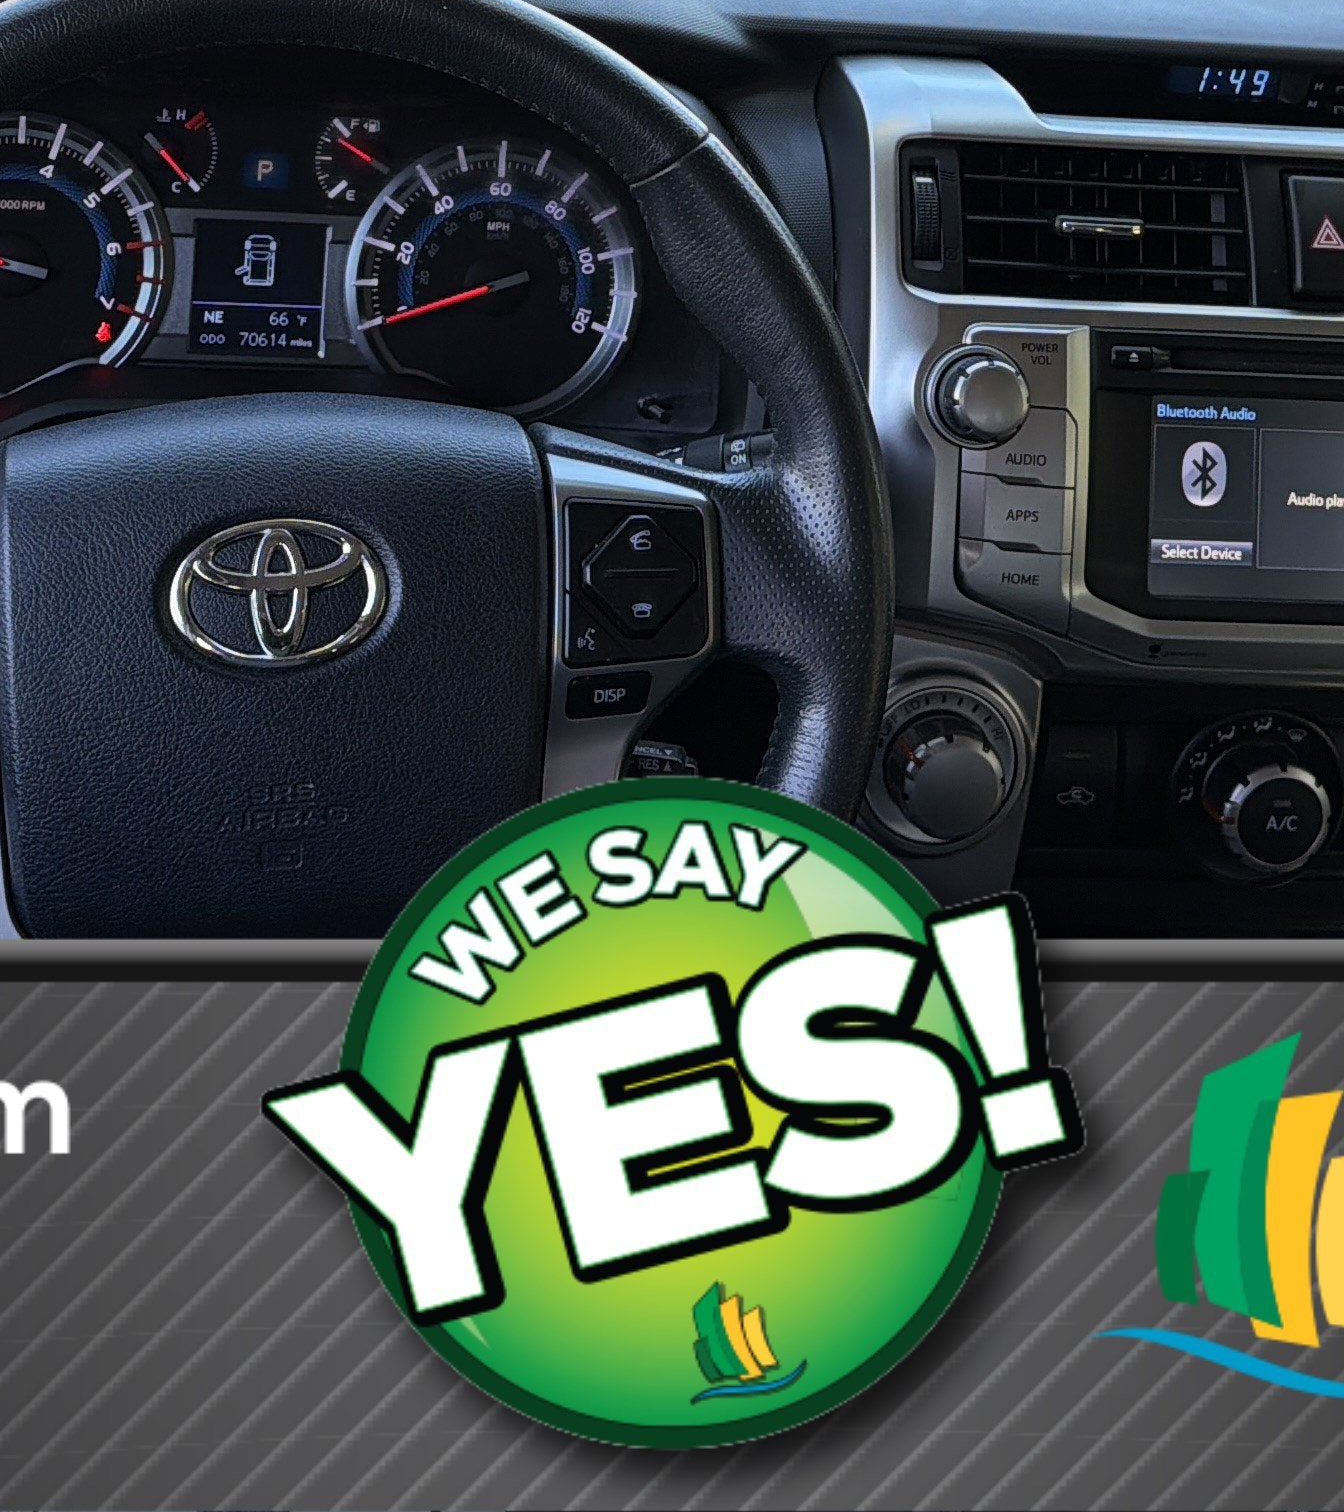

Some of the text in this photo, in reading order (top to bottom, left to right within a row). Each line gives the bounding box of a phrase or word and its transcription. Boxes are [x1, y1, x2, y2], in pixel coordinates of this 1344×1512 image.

[1198, 67, 1270, 96] 1:49
[175, 108, 187, 121] H
[349, 117, 361, 130] F
[38, 163, 55, 179] 4
[256, 159, 274, 182] P
[171, 181, 181, 194] C
[345, 189, 356, 202] E
[489, 182, 512, 198] 60
[82, 192, 101, 209] 5
[433, 194, 455, 216] 40
[543, 199, 568, 221] 80
[486, 221, 511, 233] MPH
[105, 242, 123, 256] 6
[396, 240, 415, 265] 20
[576, 246, 596, 276] 100
[98, 295, 116, 311] 7
[203, 310, 225, 325] NE
[268, 311, 289, 326] 66
[571, 308, 593, 335] 120
[199, 333, 226, 345] ODO
[238, 331, 288, 348] 70614
[1021, 342, 1059, 354] POWER
[1030, 354, 1052, 366] VOL
[1156, 403, 1256, 422] Bluetooth Audio
[730, 454, 748, 466] ON
[1005, 453, 1047, 467] AUDIO
[1286, 491, 1325, 508] Audio
[1005, 509, 1040, 523] APPS
[1161, 543, 1242, 562] Select Device
[1001, 572, 1040, 587] HOME
[593, 688, 626, 705] DISP
[638, 757, 660, 772] RES
[1265, 814, 1299, 833] A/C
